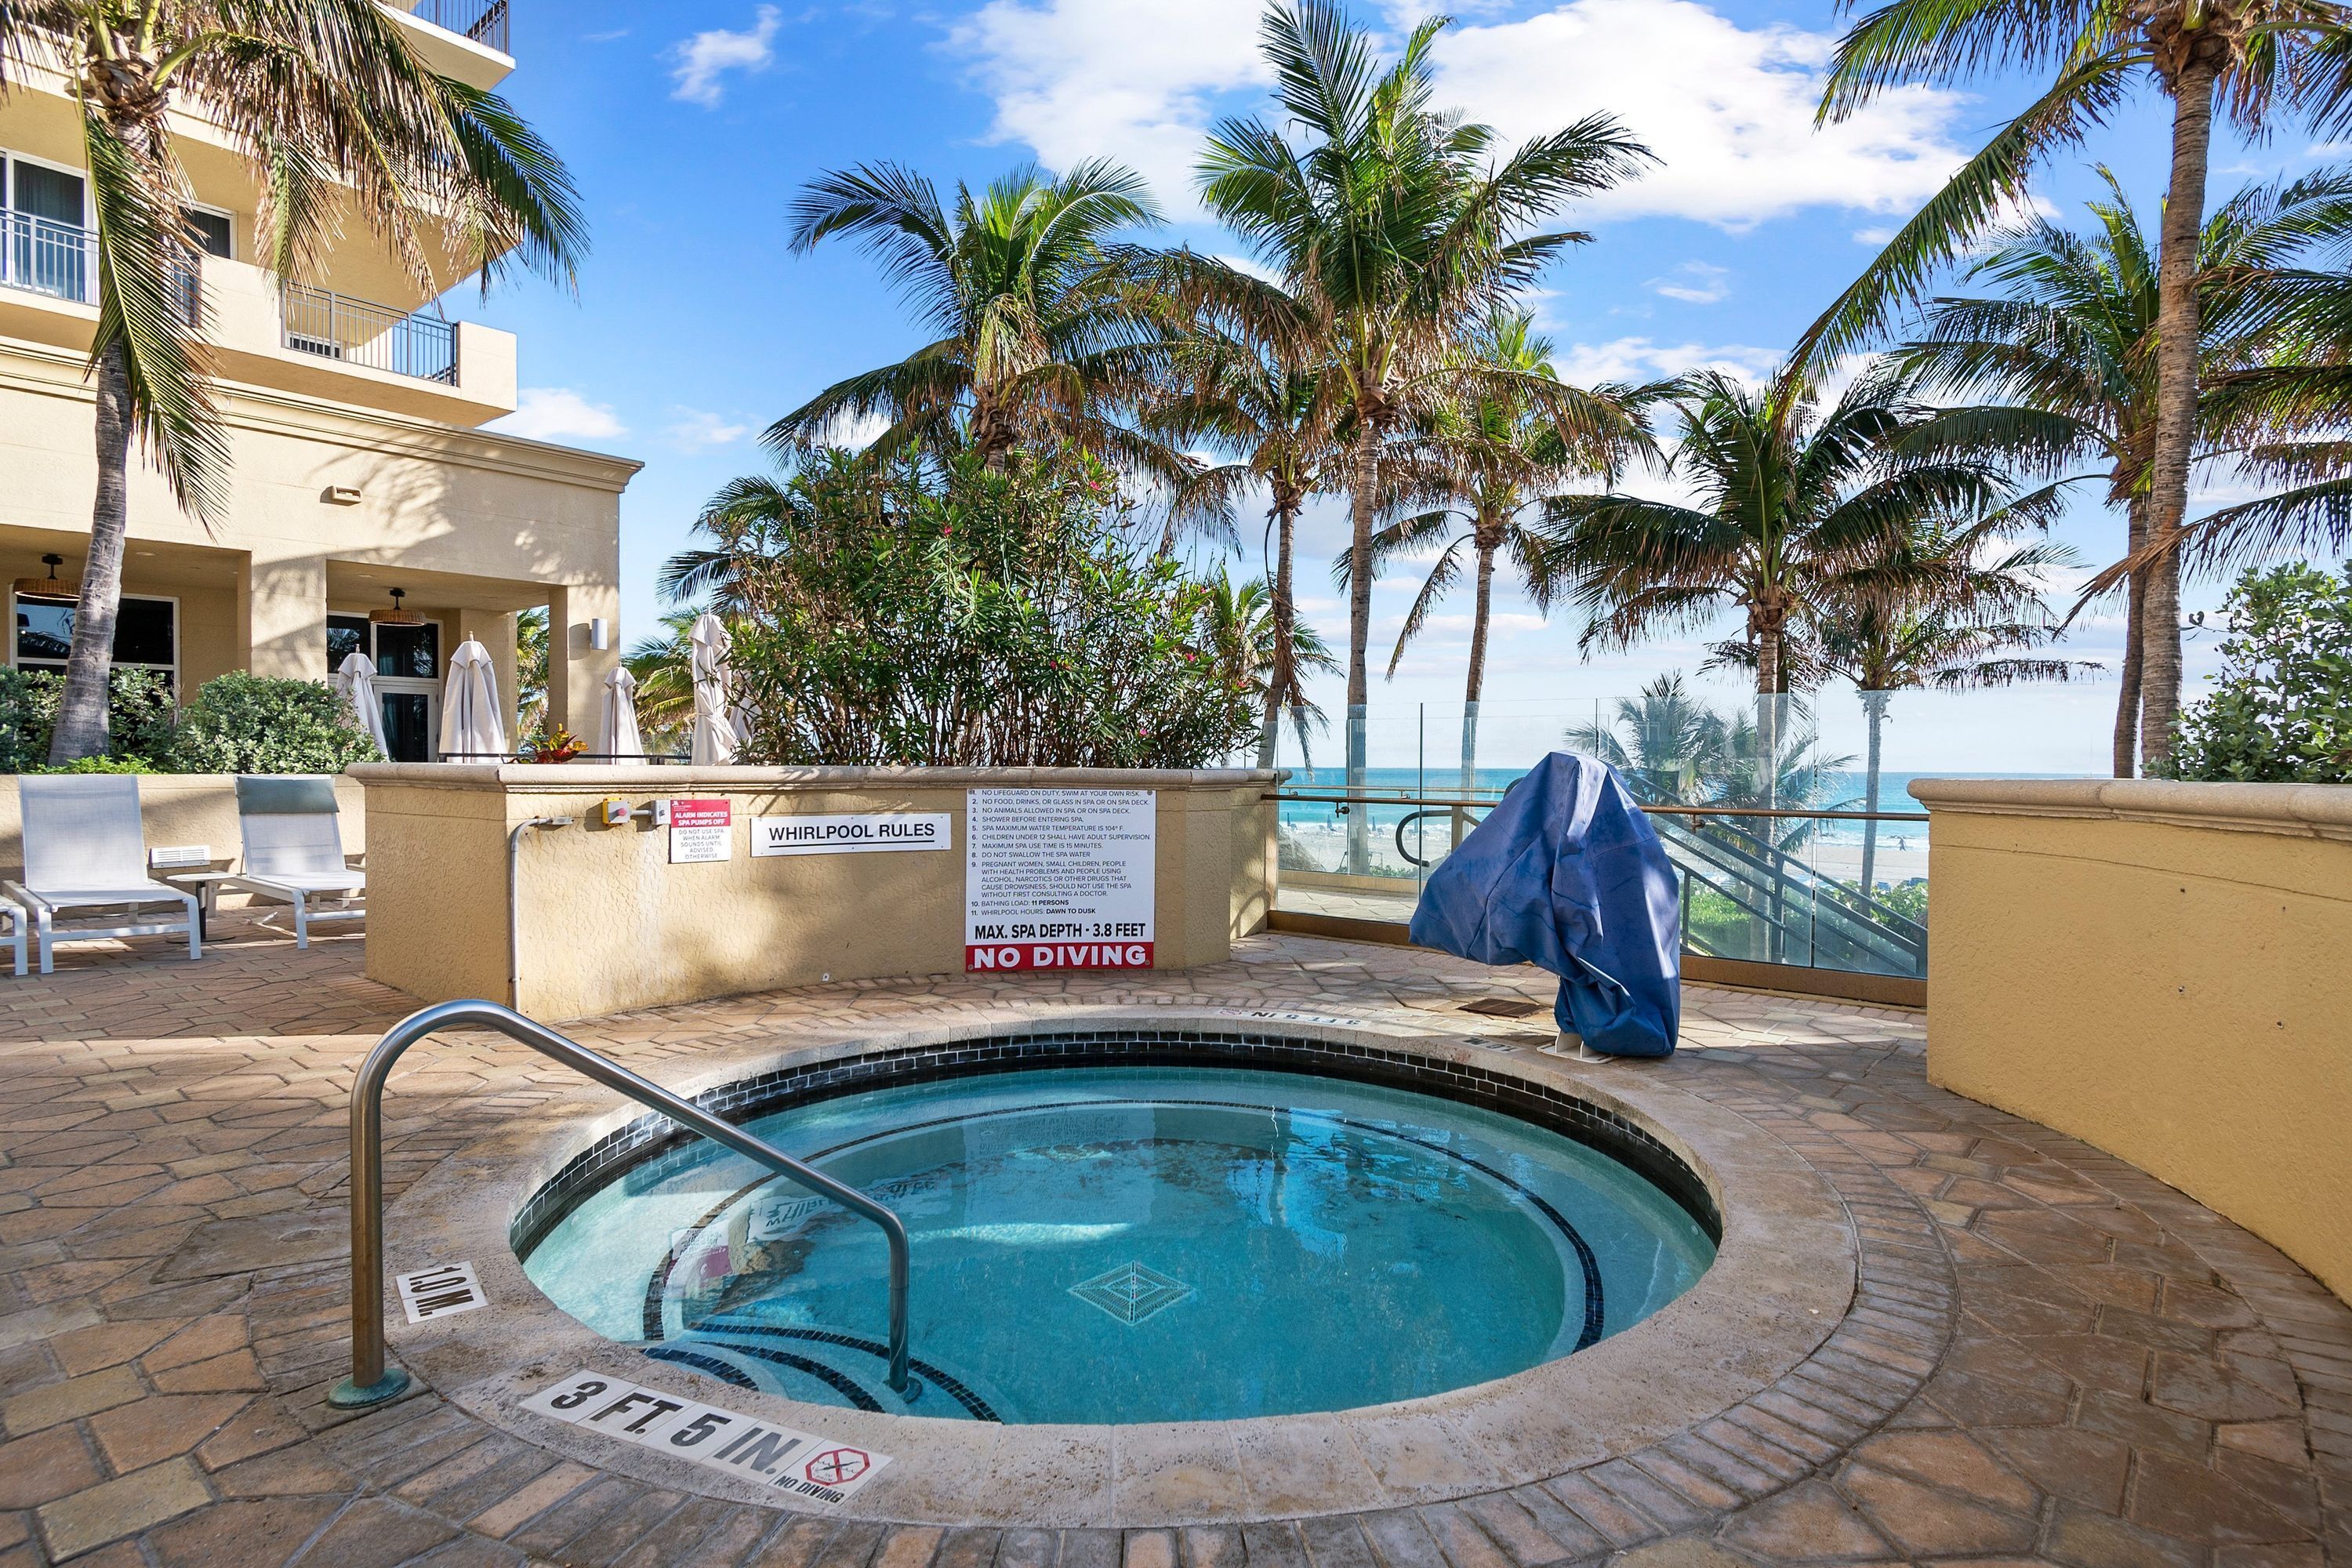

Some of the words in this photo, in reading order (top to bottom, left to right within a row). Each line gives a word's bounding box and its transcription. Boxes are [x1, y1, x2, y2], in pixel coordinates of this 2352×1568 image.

[769, 825, 873, 840] WHIRLPOOL
[879, 823, 935, 837] RULES
[975, 925, 1007, 939] MAX.
[1011, 924, 1036, 938] SPA
[1040, 924, 1082, 938] DEPTH
[1093, 924, 1112, 937] 3.8
[1116, 923, 1145, 936] FEET
[975, 947, 1020, 968] NO
[1033, 946, 1145, 967] DIVING
[408, 1267, 466, 1293] 1.0
[416, 1288, 474, 1317] M.
[550, 1381, 608, 1410] 3
[590, 1392, 684, 1434] FT.
[670, 1413, 732, 1446] 5
[713, 1428, 803, 1475] IN.
[774, 1475, 798, 1489] NO
[795, 1482, 844, 1503] DIVING
